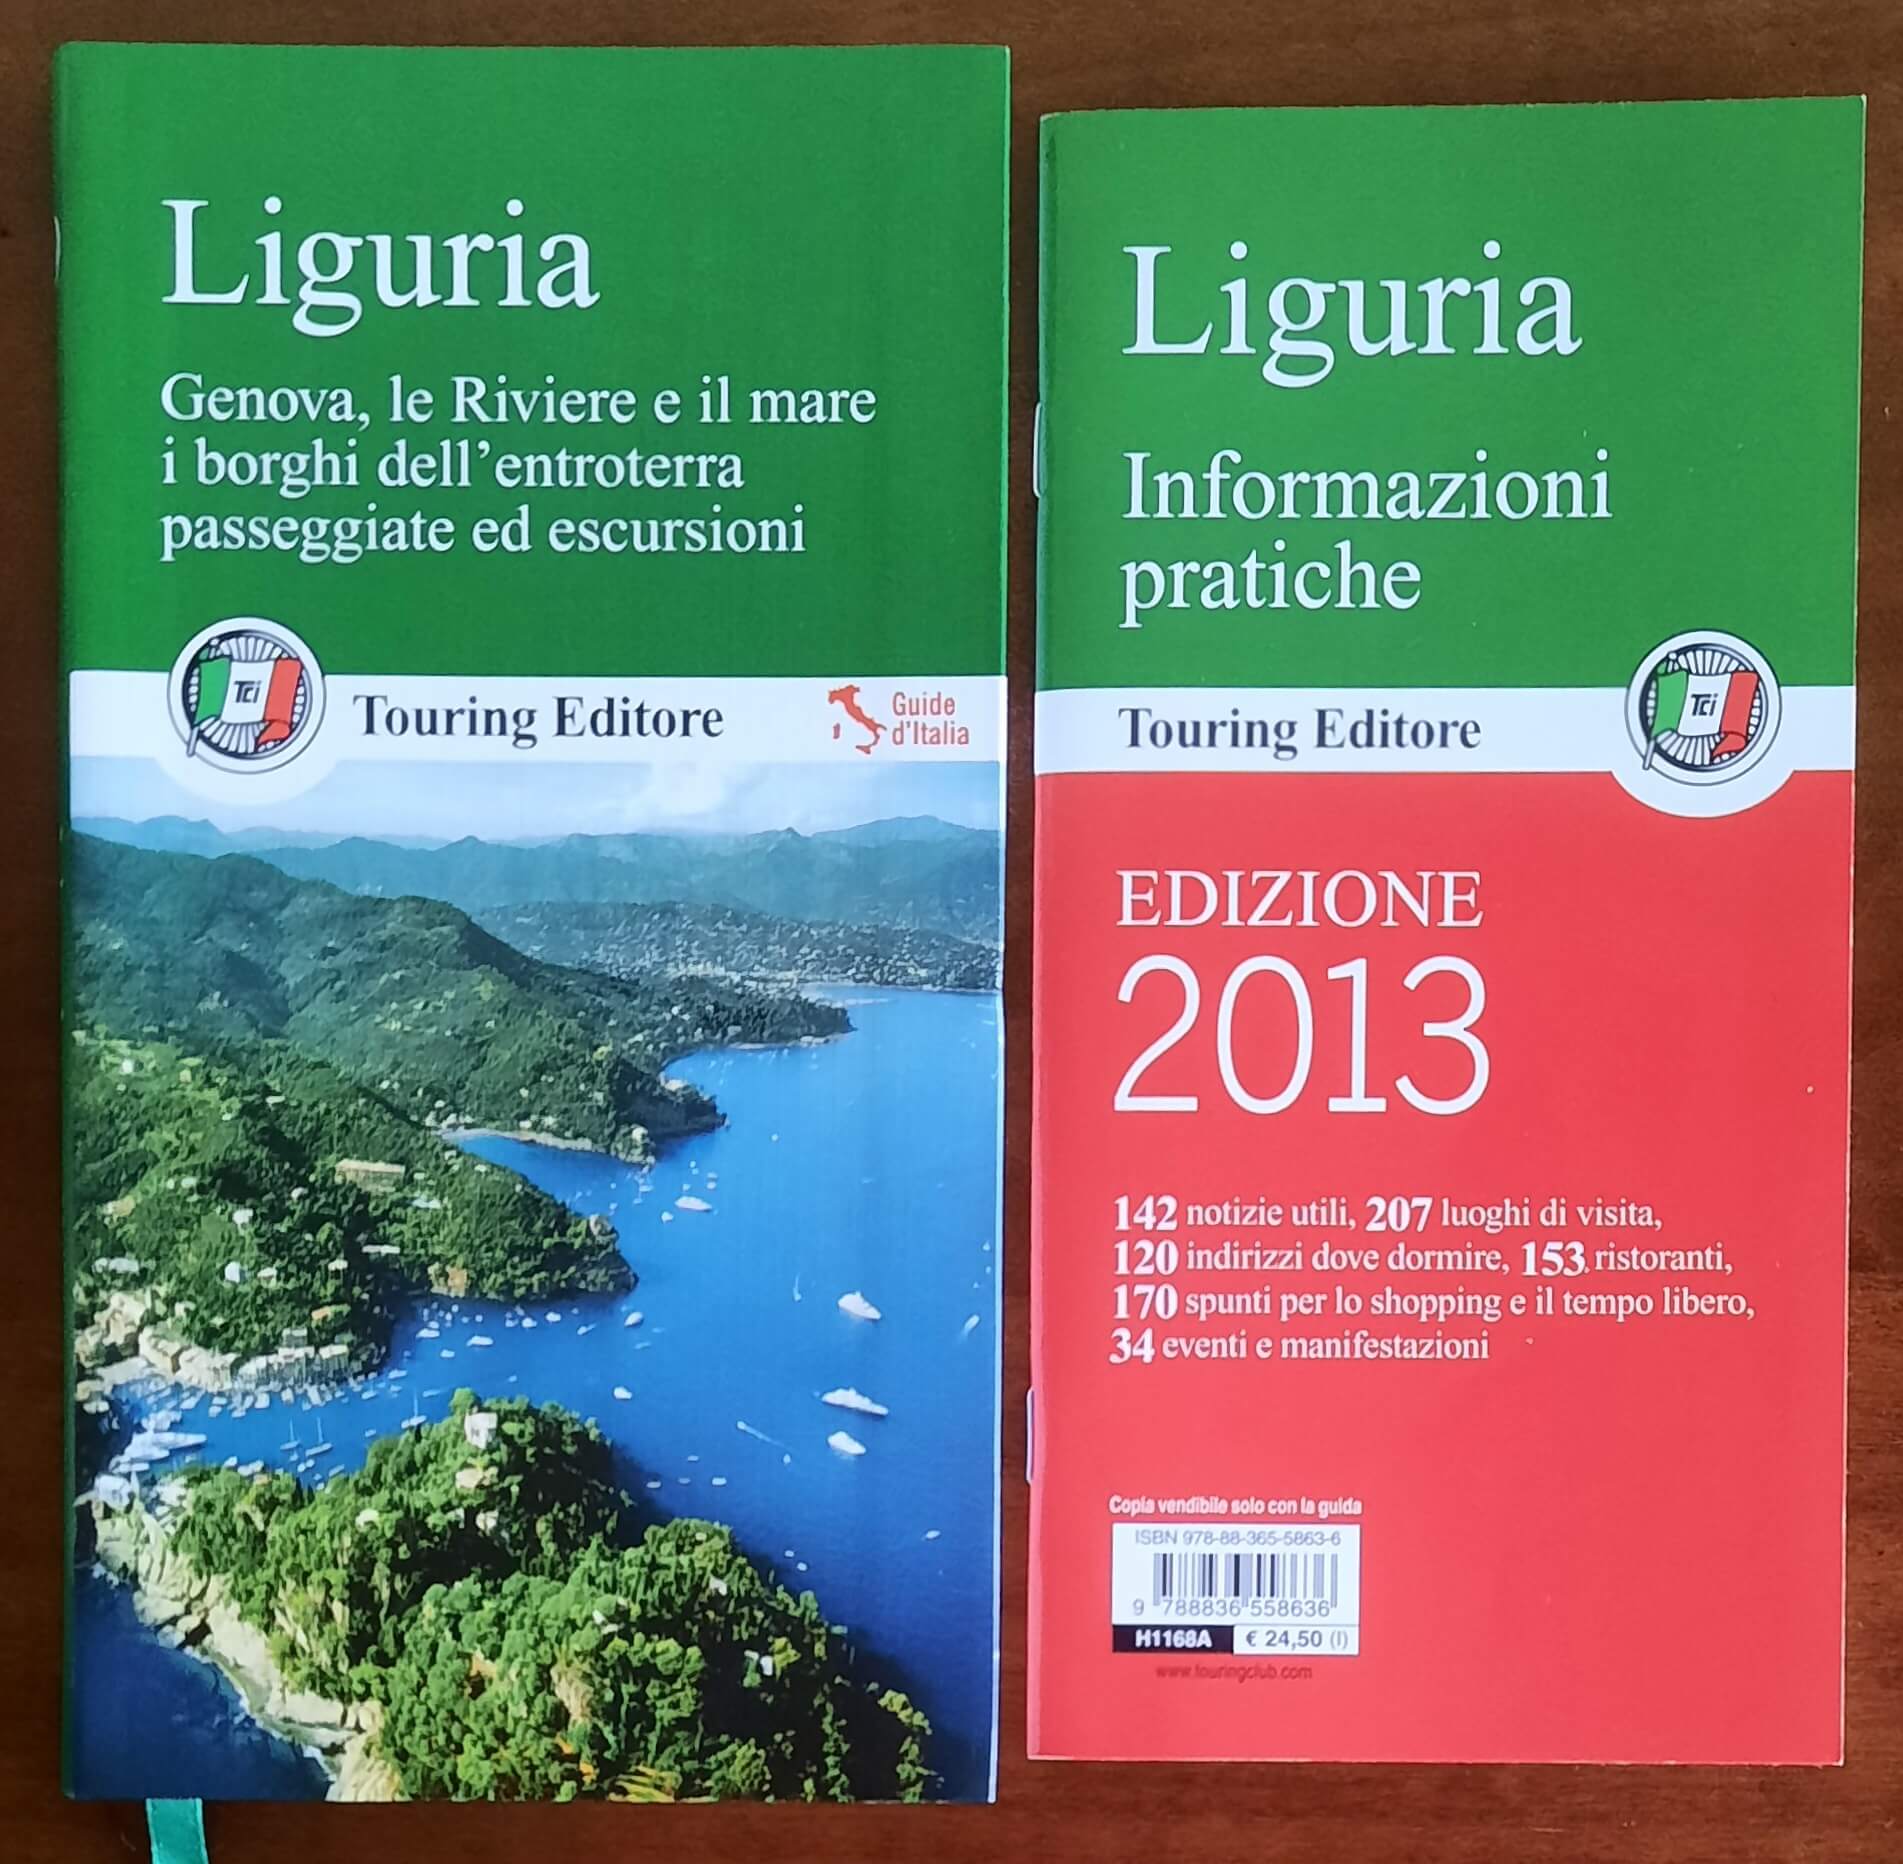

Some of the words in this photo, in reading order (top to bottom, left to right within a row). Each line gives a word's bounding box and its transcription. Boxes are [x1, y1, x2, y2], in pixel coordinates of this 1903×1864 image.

[162, 196, 601, 337] Liguria
[1122, 240, 1583, 388] Liguria
[161, 372, 370, 431] Genova,
[389, 374, 434, 423] le
[451, 374, 636, 424] Riviere
[654, 390, 681, 424] e
[699, 375, 731, 423] il
[749, 389, 876, 424] mare
[162, 435, 177, 484] i
[194, 436, 359, 499] borghi
[1123, 448, 1613, 520] Informazioni
[159, 502, 455, 564] passeggiate
[472, 503, 532, 552] ed
[548, 503, 806, 553] escursioni
[1119, 539, 1421, 628] pratiche
[353, 695, 538, 749] Touring
[554, 696, 724, 738] Editore
[892, 691, 956, 716] Guide
[891, 720, 970, 745] d'Italia
[1118, 707, 1298, 760] Touring
[1315, 708, 1481, 749] Editore
[1116, 870, 1483, 928] EDIZIONE
[1114, 954, 1490, 1115] 2013
[1114, 1195, 1178, 1231] 142
[1186, 1196, 1283, 1226] notizie
[1291, 1197, 1356, 1230] utili,
[1365, 1196, 1433, 1233] 207
[1441, 1197, 1530, 1234] luoghi
[1539, 1197, 1567, 1227] di
[1576, 1198, 1662, 1230] visita,
[1114, 1239, 1179, 1276] 120
[1187, 1240, 1303, 1270] indirizzi
[1311, 1241, 1380, 1271] dove
[1387, 1242, 1510, 1275] dormire,
[1521, 1241, 1586, 1277] 153
[1595, 1242, 1733, 1275] ristoranti,
[1113, 1283, 1179, 1320] 170
[1185, 1285, 1271, 1322] spunti
[1279, 1293, 1328, 1322] per
[1335, 1285, 1363, 1315] lo
[1370, 1285, 1502, 1323] shopping
[1509, 1294, 1526, 1315] e
[1535, 1285, 1554, 1315] il
[1562, 1291, 1654, 1323] tempo
[1663, 1286, 1755, 1319] libero,
[1109, 1327, 1156, 1364] 34
[1162, 1329, 1247, 1359] eventi
[1255, 1337, 1273, 1359] e
[1280, 1329, 1489, 1359] manifestazioni
[1108, 1494, 1156, 1518] Copia
[1157, 1495, 1229, 1515] vendibile
[1230, 1496, 1266, 1515] solo
[1267, 1499, 1298, 1515] con
[1300, 1496, 1316, 1515] la
[1317, 1497, 1363, 1519] guida
[1135, 1529, 1178, 1546] ISBN
[1182, 1529, 1342, 1546] 978-88-365-5863-6
[1132, 1599, 1145, 1616] 9
[1162, 1599, 1242, 1618] 788836
[1250, 1599, 1331, 1618] 558636
[1135, 1629, 1213, 1649] H1168A
[1245, 1631, 1258, 1648] €
[1264, 1630, 1324, 1651] 24,50
[1155, 1664, 1313, 1684] www.touringclub.com
